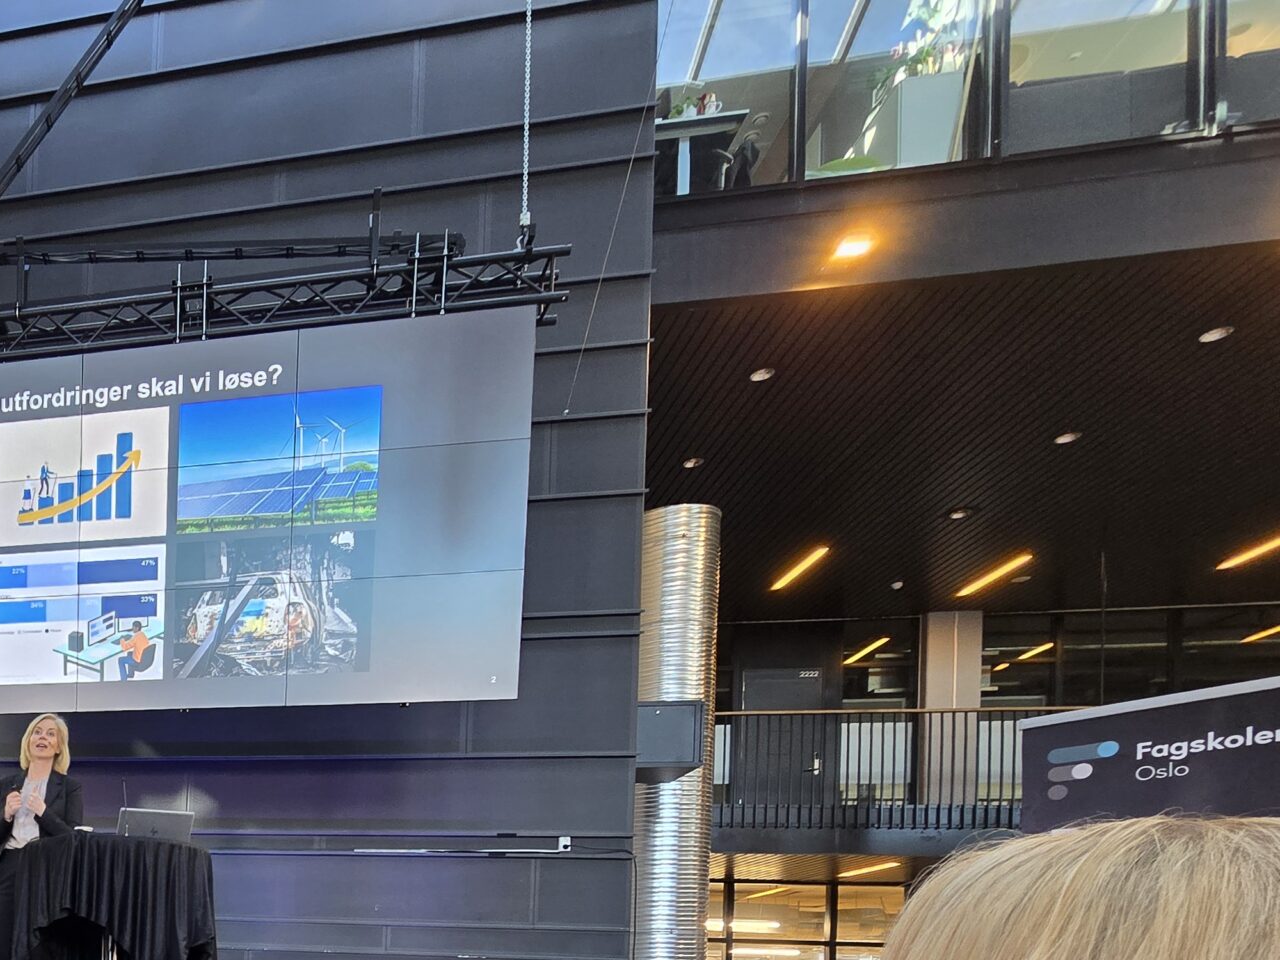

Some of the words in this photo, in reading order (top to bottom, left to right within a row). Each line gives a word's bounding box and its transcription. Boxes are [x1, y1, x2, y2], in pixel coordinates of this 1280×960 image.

[1, 383, 132, 412] utfordringer
[138, 375, 183, 398] skal
[190, 372, 211, 393] vi
[218, 364, 283, 390] løse?
[1135, 762, 1189, 781] Oslo
